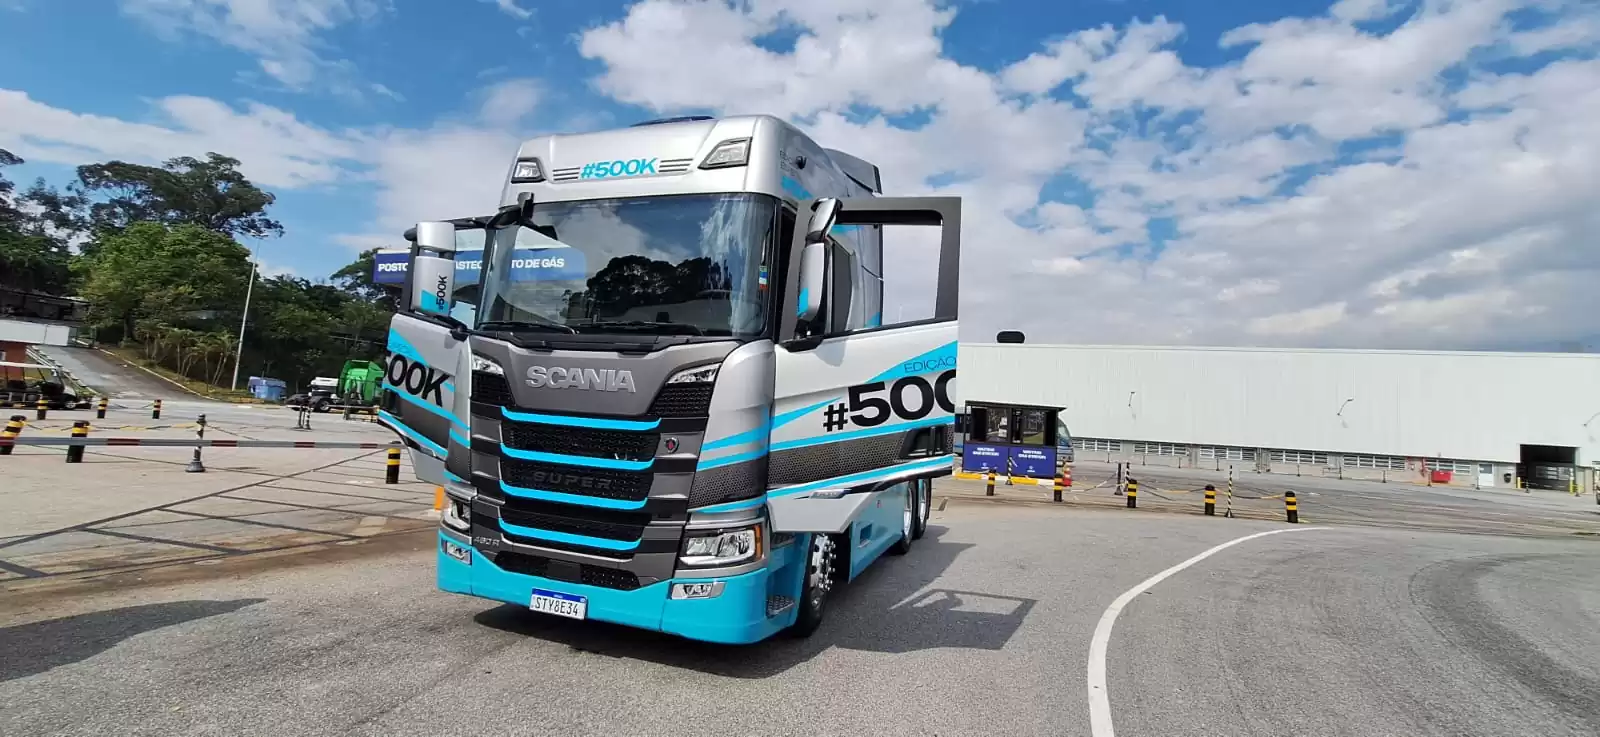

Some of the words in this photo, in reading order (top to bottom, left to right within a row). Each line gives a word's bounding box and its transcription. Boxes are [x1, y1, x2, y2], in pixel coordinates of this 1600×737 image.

[581, 157, 658, 178] #500K
[378, 262, 408, 272] POSTO
[525, 258, 541, 269] DE
[542, 256, 565, 268] GÁS
[435, 274, 448, 310] #500K
[384, 354, 450, 407] 00K
[525, 366, 636, 393] SCANIA
[533, 470, 614, 490] SUPER
[535, 597, 578, 616] STY8E34
